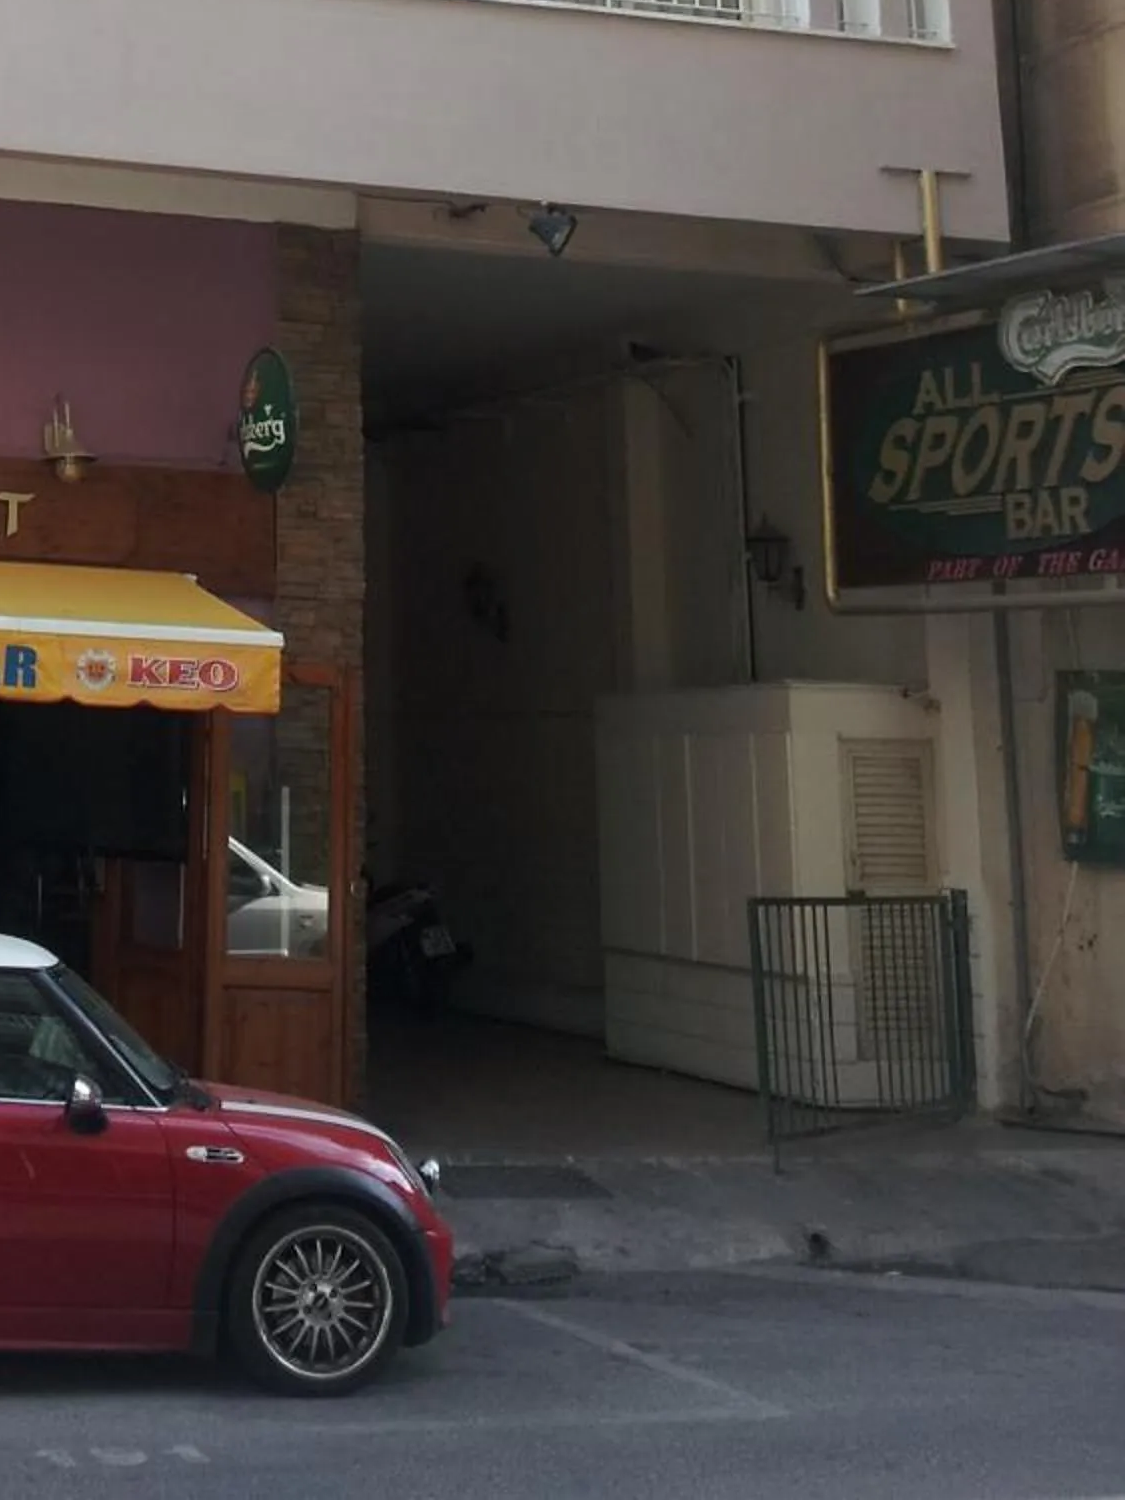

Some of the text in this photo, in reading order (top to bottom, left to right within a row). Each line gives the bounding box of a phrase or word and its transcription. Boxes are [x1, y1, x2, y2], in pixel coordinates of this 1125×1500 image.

[912, 361, 1001, 414] ALL
[868, 385, 1125, 503] SPORTS
[1005, 485, 1093, 540] BAR
[927, 547, 1125, 582] PART OF THE GA
[126, 653, 240, 693] KEO
